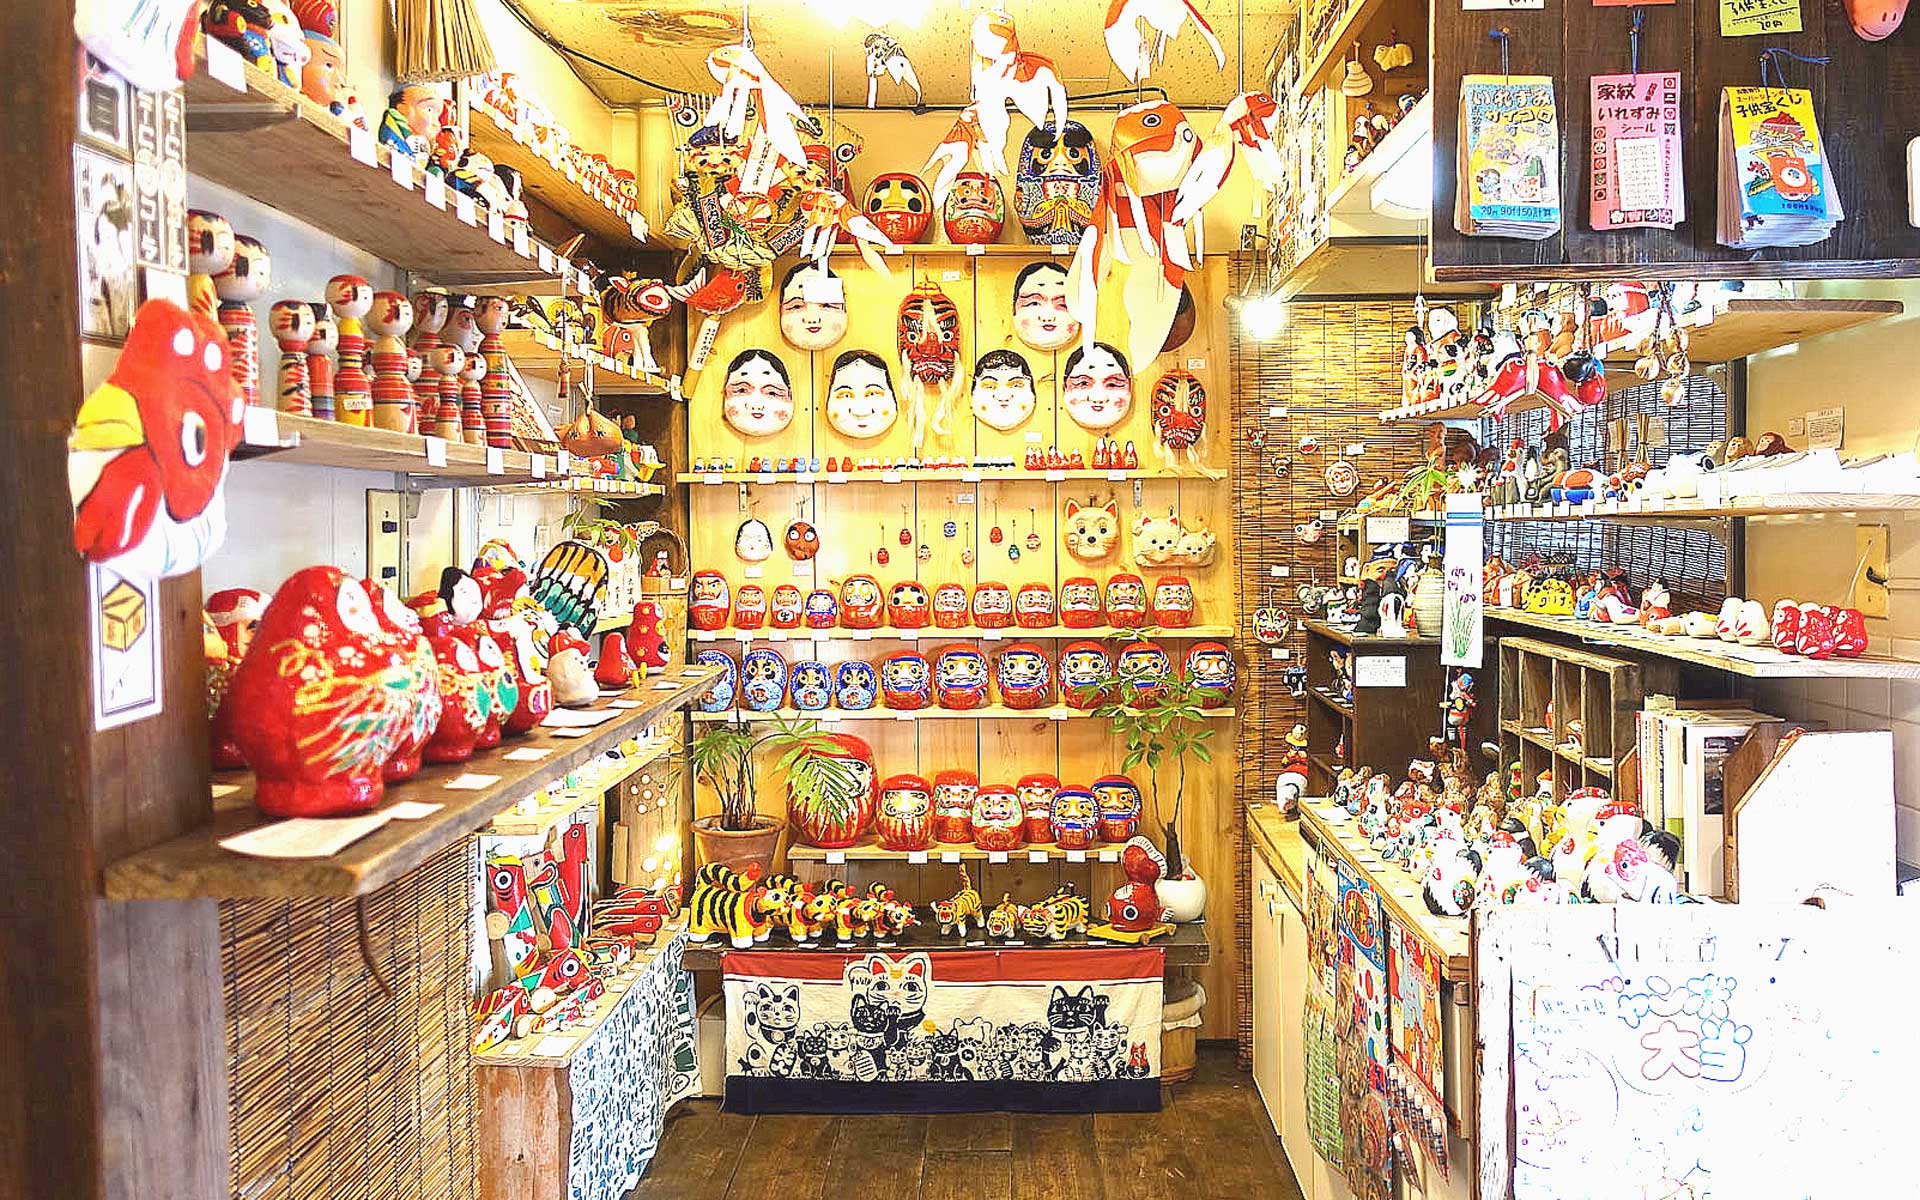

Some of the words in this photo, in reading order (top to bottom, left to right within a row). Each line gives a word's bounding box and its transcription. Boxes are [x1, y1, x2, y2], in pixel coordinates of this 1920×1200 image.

[1472, 88, 1552, 107] いれずみ
[1597, 83, 1637, 101] 家紋
[1598, 106, 1661, 121] いれずみ
[1735, 92, 1803, 118] 子供宝くじ
[1620, 123, 1657, 134] シール
